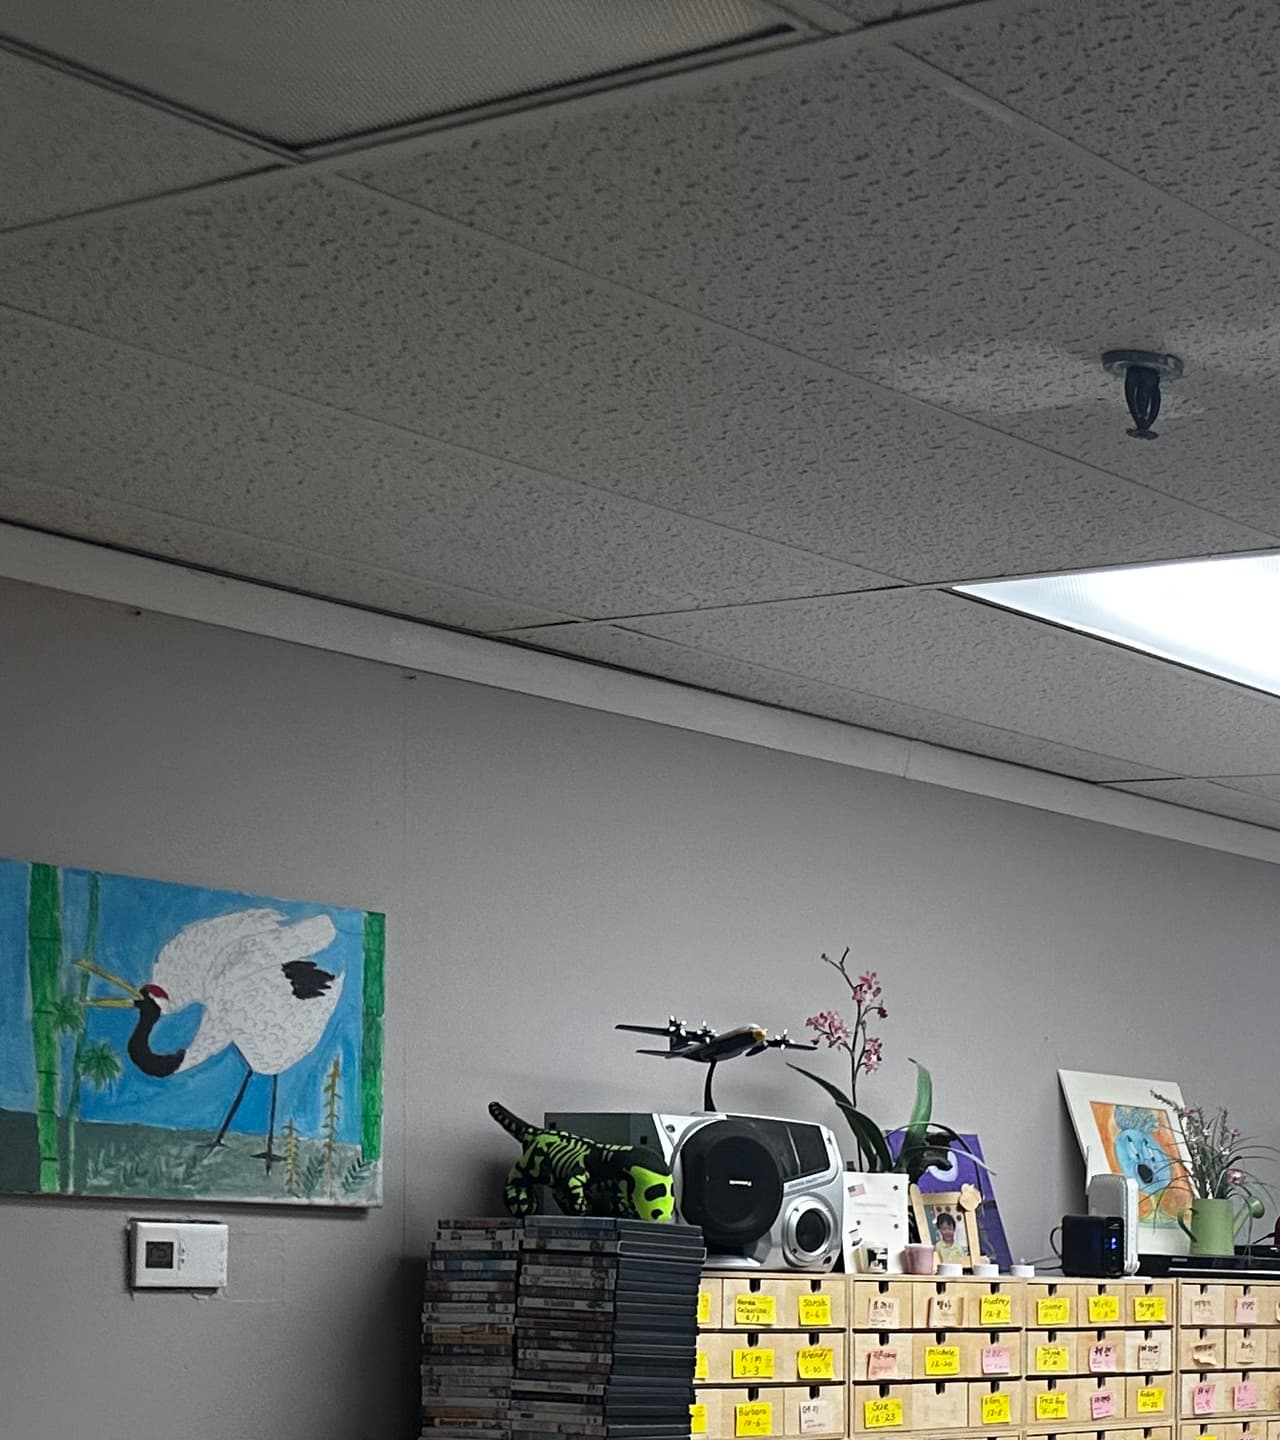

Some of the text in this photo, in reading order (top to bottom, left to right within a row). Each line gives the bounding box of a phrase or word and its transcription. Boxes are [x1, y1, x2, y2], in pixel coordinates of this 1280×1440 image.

[741, 1352, 762, 1364] Kim
[741, 1366, 760, 1376] 3-3
[872, 1402, 889, 1412] Sue
[869, 1413, 897, 1423] 12-23
